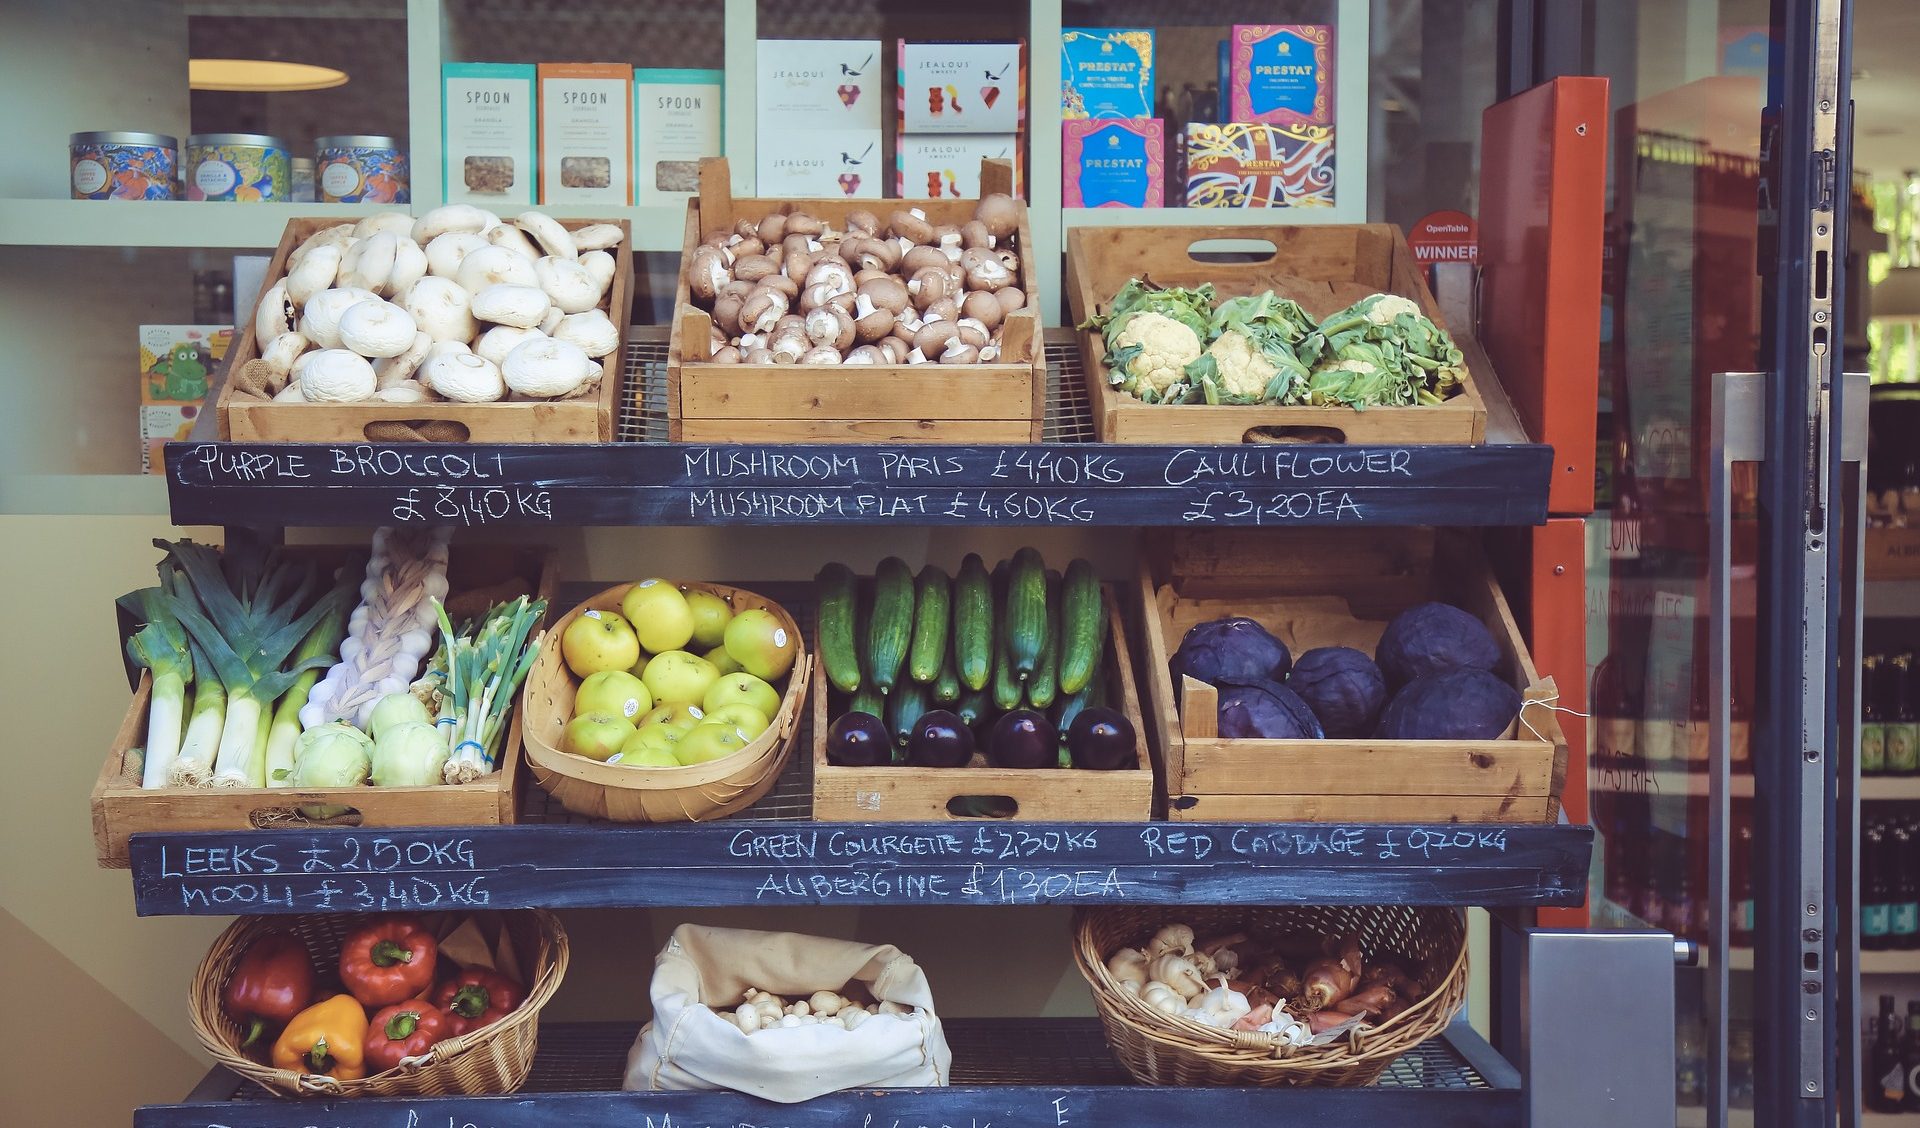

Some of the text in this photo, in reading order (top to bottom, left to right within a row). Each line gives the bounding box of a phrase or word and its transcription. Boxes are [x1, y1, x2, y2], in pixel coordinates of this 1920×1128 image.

[920, 61, 969, 69] JEALOUS
[1078, 62, 1136, 72] PRESTAT
[1255, 65, 1313, 76] PRESTAT
[774, 71, 825, 79] JEALOUS
[466, 91, 510, 104] SPOON
[563, 92, 607, 104] SPOON
[658, 96, 701, 109] SPOON
[918, 146, 967, 154] JEALOUS
[774, 159, 825, 168] JEALOUS
[1085, 158, 1143, 168] PRESTAT
[1426, 224, 1469, 234] OpenTable
[1415, 246, 1478, 259] WINNER
[194, 445, 503, 482] PURPLE BROCCOLI
[685, 448, 859, 480] MUSHROOM
[878, 452, 964, 479] PARIS
[1164, 449, 1412, 486] CAULIFLOWER
[690, 489, 846, 518] MUSHROOM
[856, 494, 928, 517] FLAT
[729, 829, 818, 858] GREEN
[1139, 827, 1213, 860] RED
[1231, 828, 1366, 856] CABBAGE
[161, 843, 280, 879] LEEKS
[755, 871, 950, 900] AUBERGINE
[181, 883, 294, 908] MOOLI
